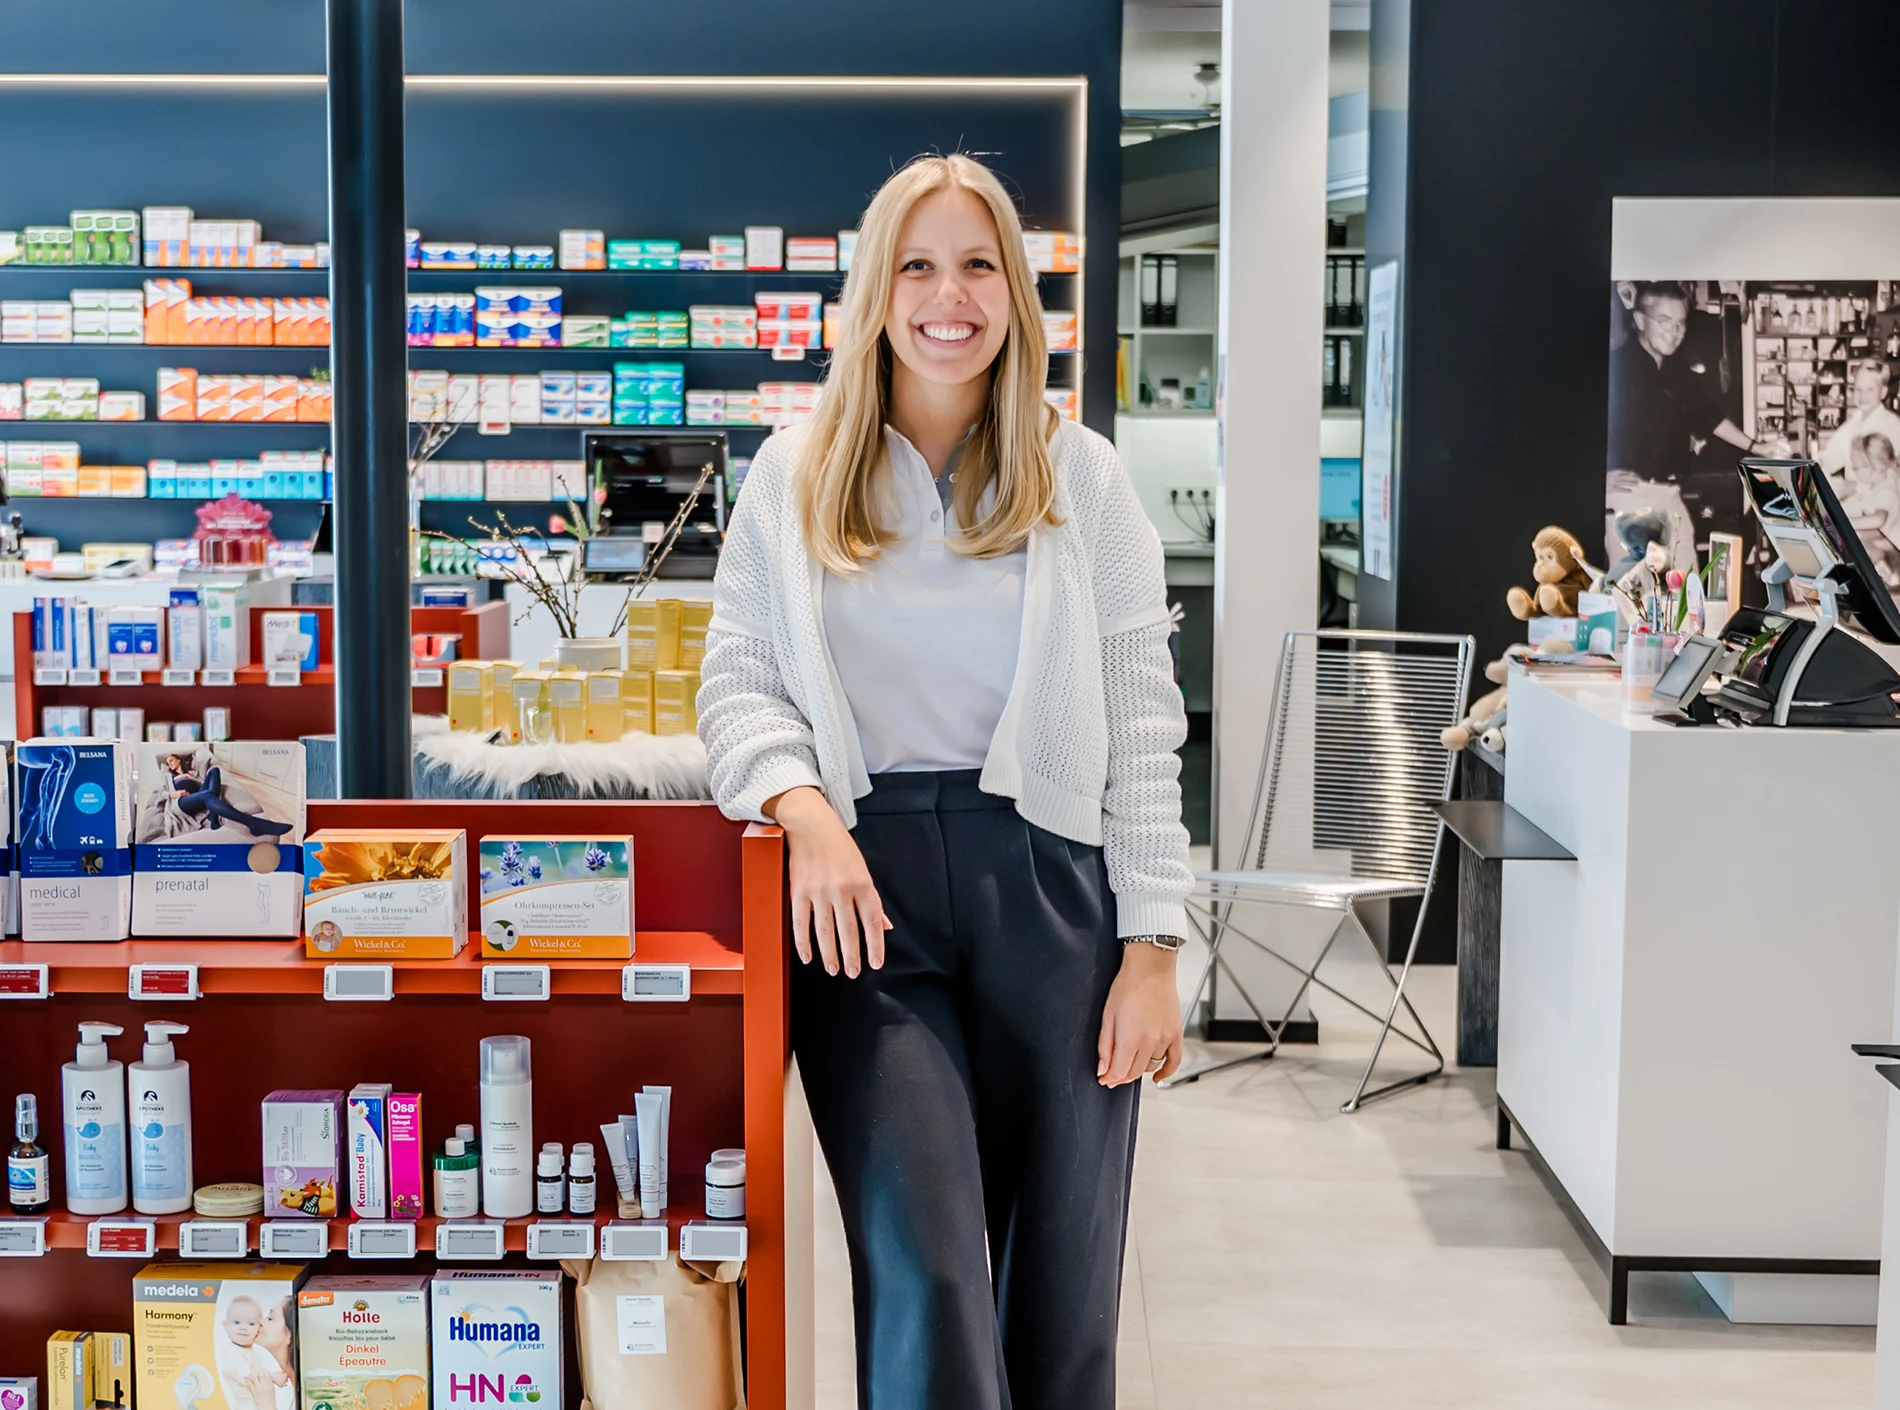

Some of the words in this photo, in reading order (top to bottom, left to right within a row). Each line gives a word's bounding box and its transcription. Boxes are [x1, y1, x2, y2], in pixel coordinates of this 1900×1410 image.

[79, 751, 108, 759] BELSANA
[29, 884, 81, 900] medical
[155, 877, 209, 894] prenatal
[331, 905, 360, 914] Bauch-
[361, 905, 379, 914] und
[380, 905, 428, 914] Brustwickel
[514, 901, 595, 912] Ohrkompressen-Set
[390, 1100, 415, 1113] Osa
[355, 1133, 366, 1153] Baby
[356, 1155, 366, 1208] Kamistad
[451, 1271, 516, 1279] Humana
[144, 1284, 199, 1297] medela
[301, 1295, 331, 1305] demeter
[145, 1309, 194, 1323] Harmony
[342, 1311, 381, 1323] Holle
[335, 1328, 389, 1336] Bio-Babyzwieback
[449, 1316, 541, 1342] Humana
[345, 1344, 380, 1354] Dinkel
[59, 1347, 69, 1380] Purelan
[75, 1347, 83, 1376] medela
[339, 1354, 387, 1368] Épeautre
[449, 1372, 505, 1403] HN
[509, 1384, 540, 1392] EXPERT
